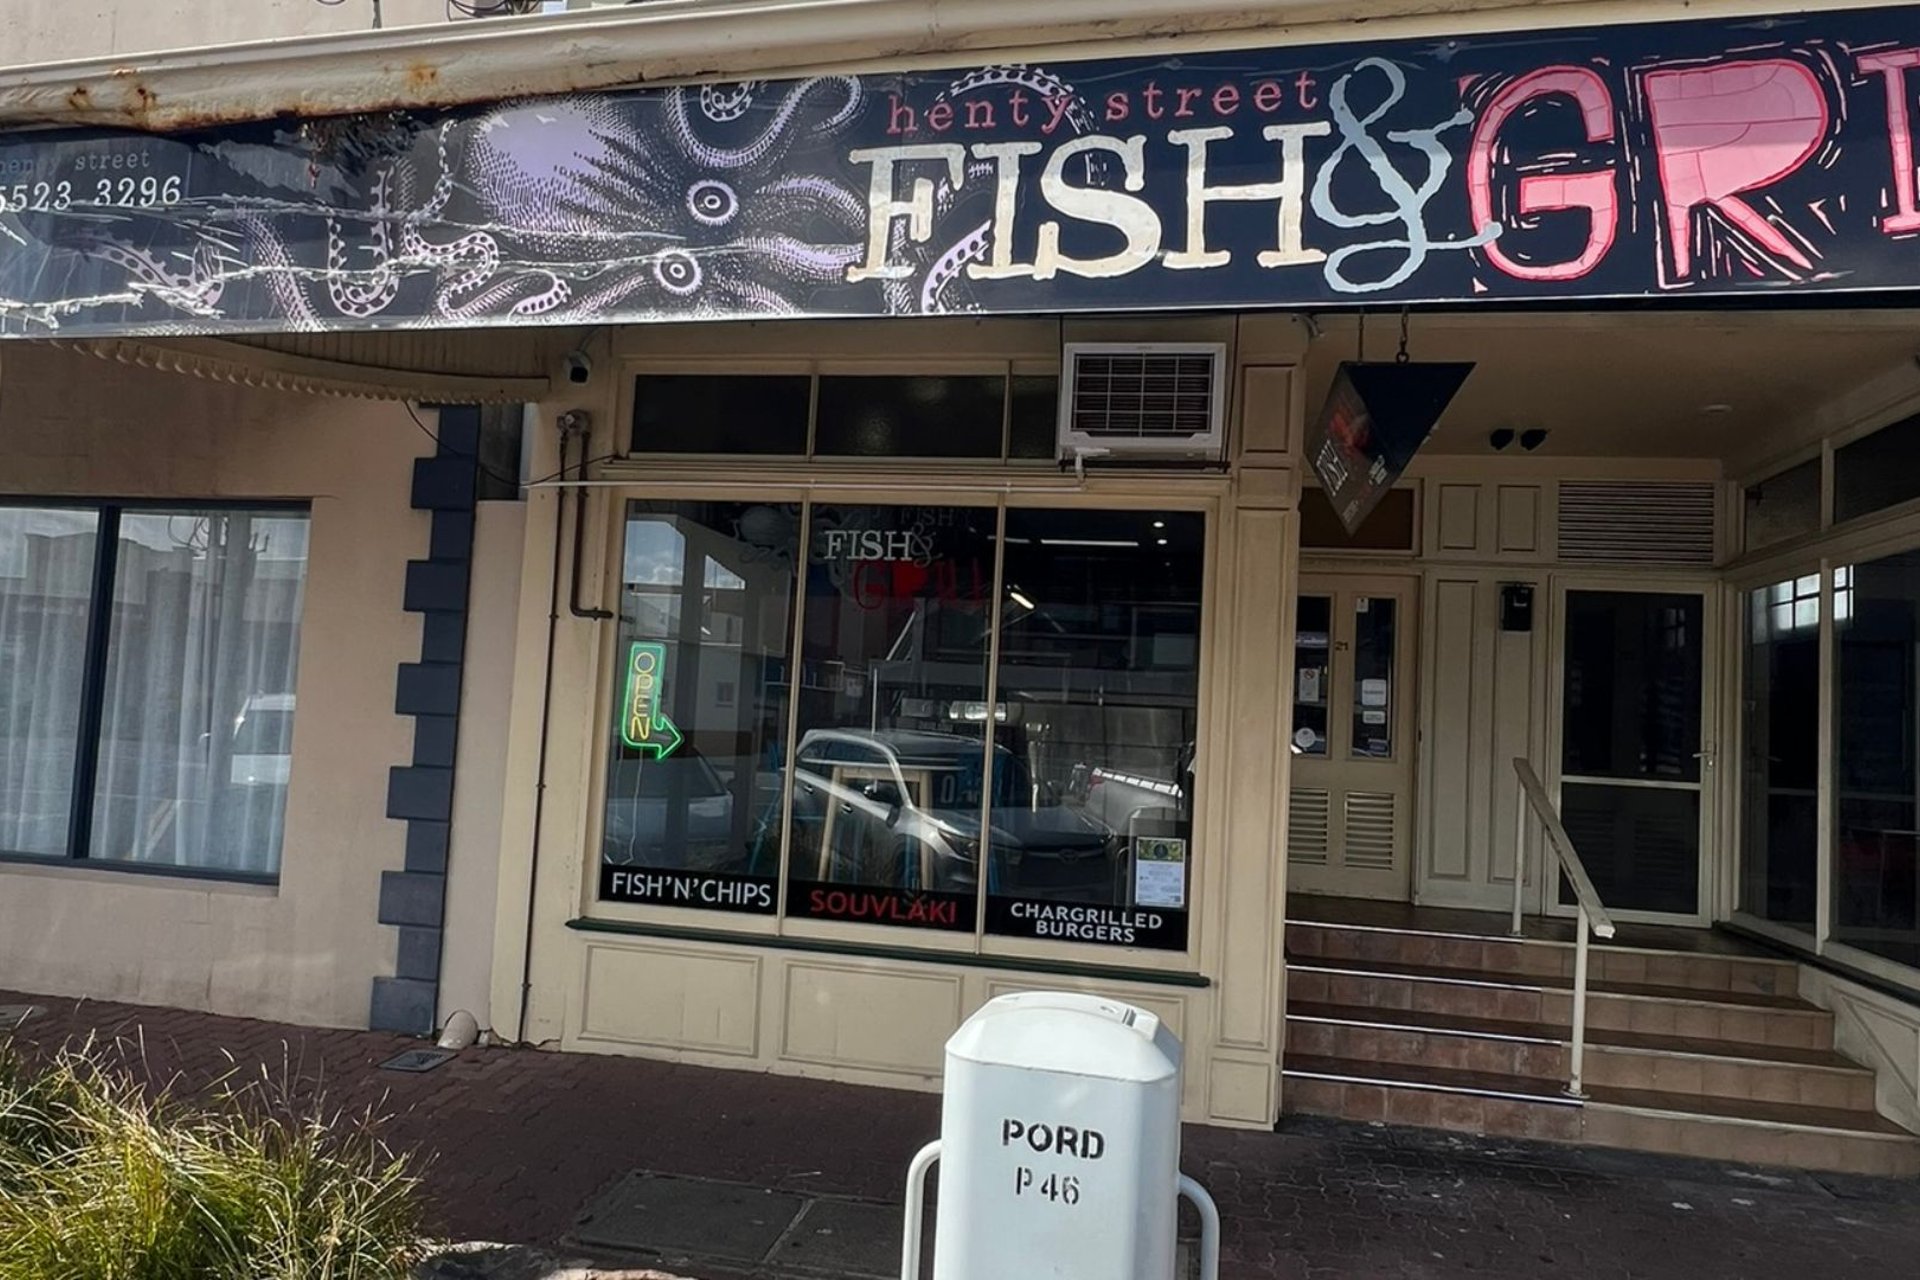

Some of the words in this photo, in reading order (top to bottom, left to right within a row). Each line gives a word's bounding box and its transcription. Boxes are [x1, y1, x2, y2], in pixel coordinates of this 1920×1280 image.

[886, 87, 1072, 135] henty
[1104, 71, 1318, 123] street
[0, 158, 60, 177] eny
[75, 149, 151, 171] street
[846, 121, 1332, 284] FISH
[1310, 57, 1503, 294] &
[93, 175, 182, 207] 3296
[823, 530, 913, 561] FISH
[630, 652, 656, 740] OPEN
[810, 889, 957, 925] SOUVLAKI
[1010, 902, 1163, 929] CHARGRILLED
[1035, 920, 1136, 943] BURGERS
[1002, 1118, 1105, 1160] PORD
